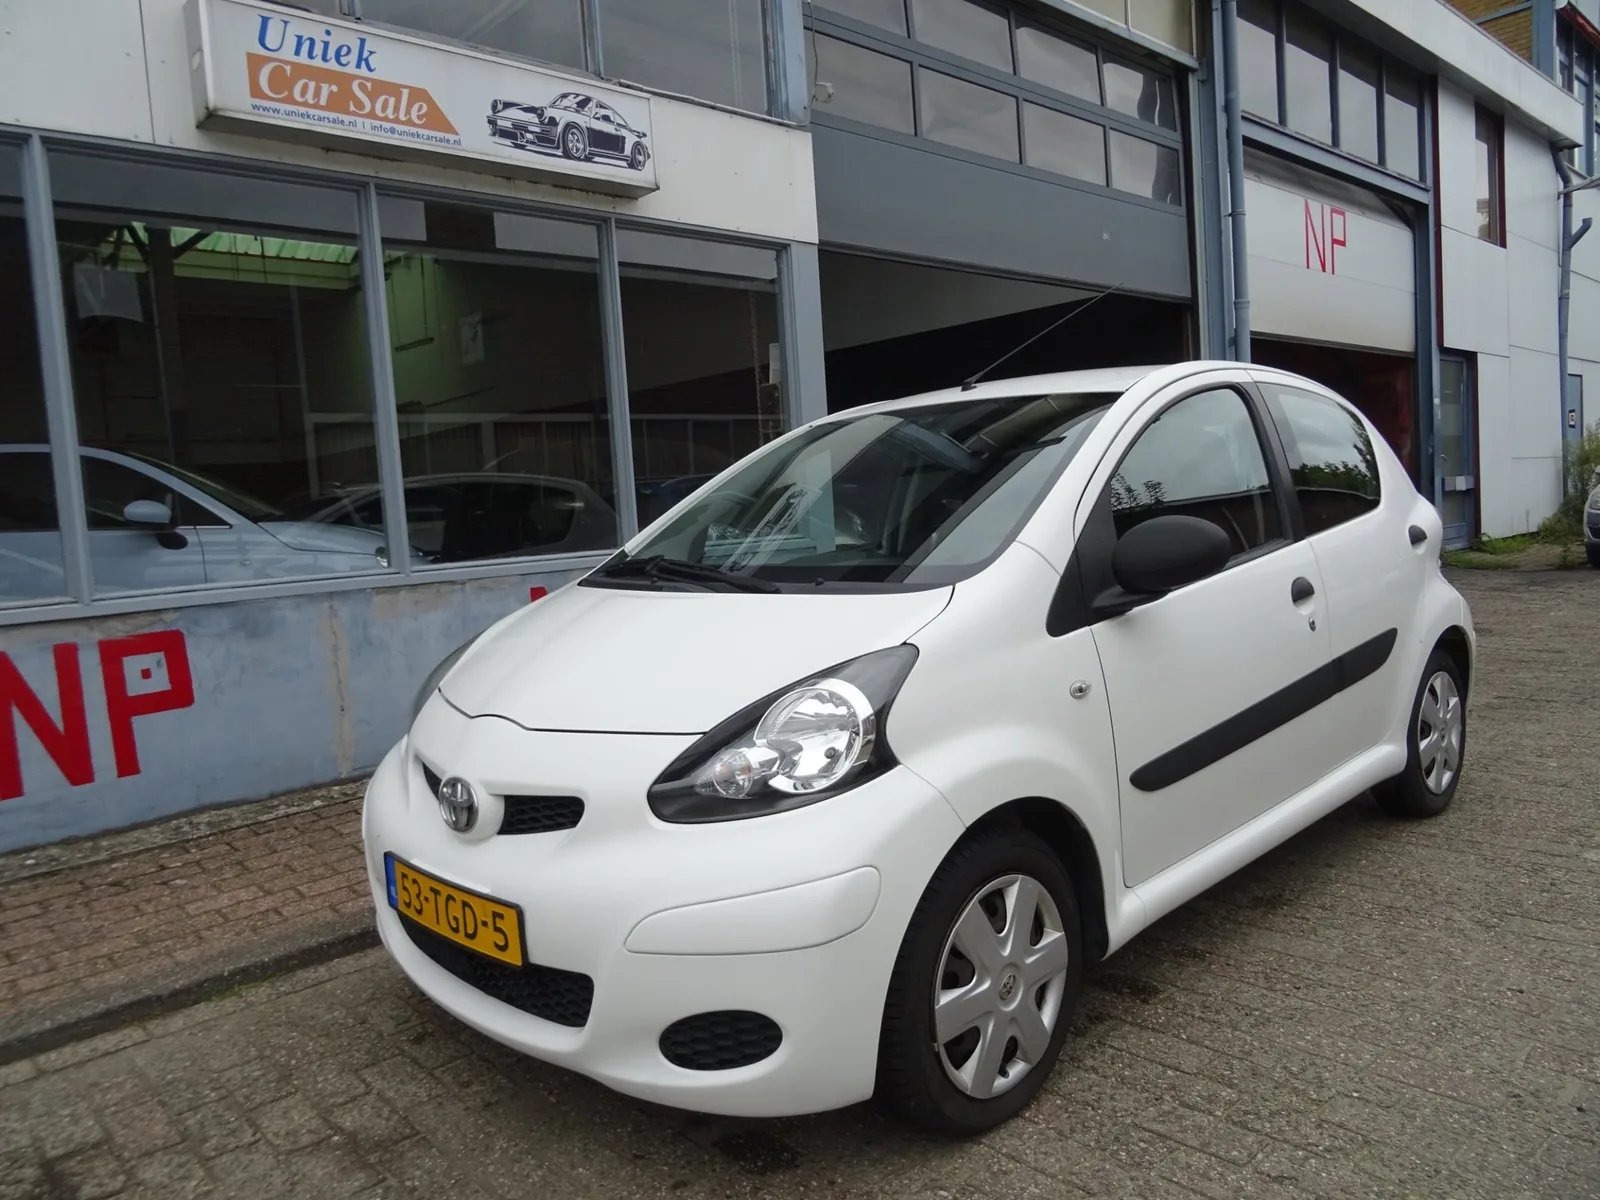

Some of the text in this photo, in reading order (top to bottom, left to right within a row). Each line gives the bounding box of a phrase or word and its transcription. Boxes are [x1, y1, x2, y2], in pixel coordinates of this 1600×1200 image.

[257, 14, 377, 73] Uniek
[251, 102, 358, 128] www.uniekcarsale.nl
[370, 122, 462, 147] info@uniekcarsale.nl
[258, 61, 428, 124] Car Sale
[1304, 199, 1347, 275] NP
[0, 629, 195, 799] NP
[401, 870, 509, 953] 53-TGD-5
